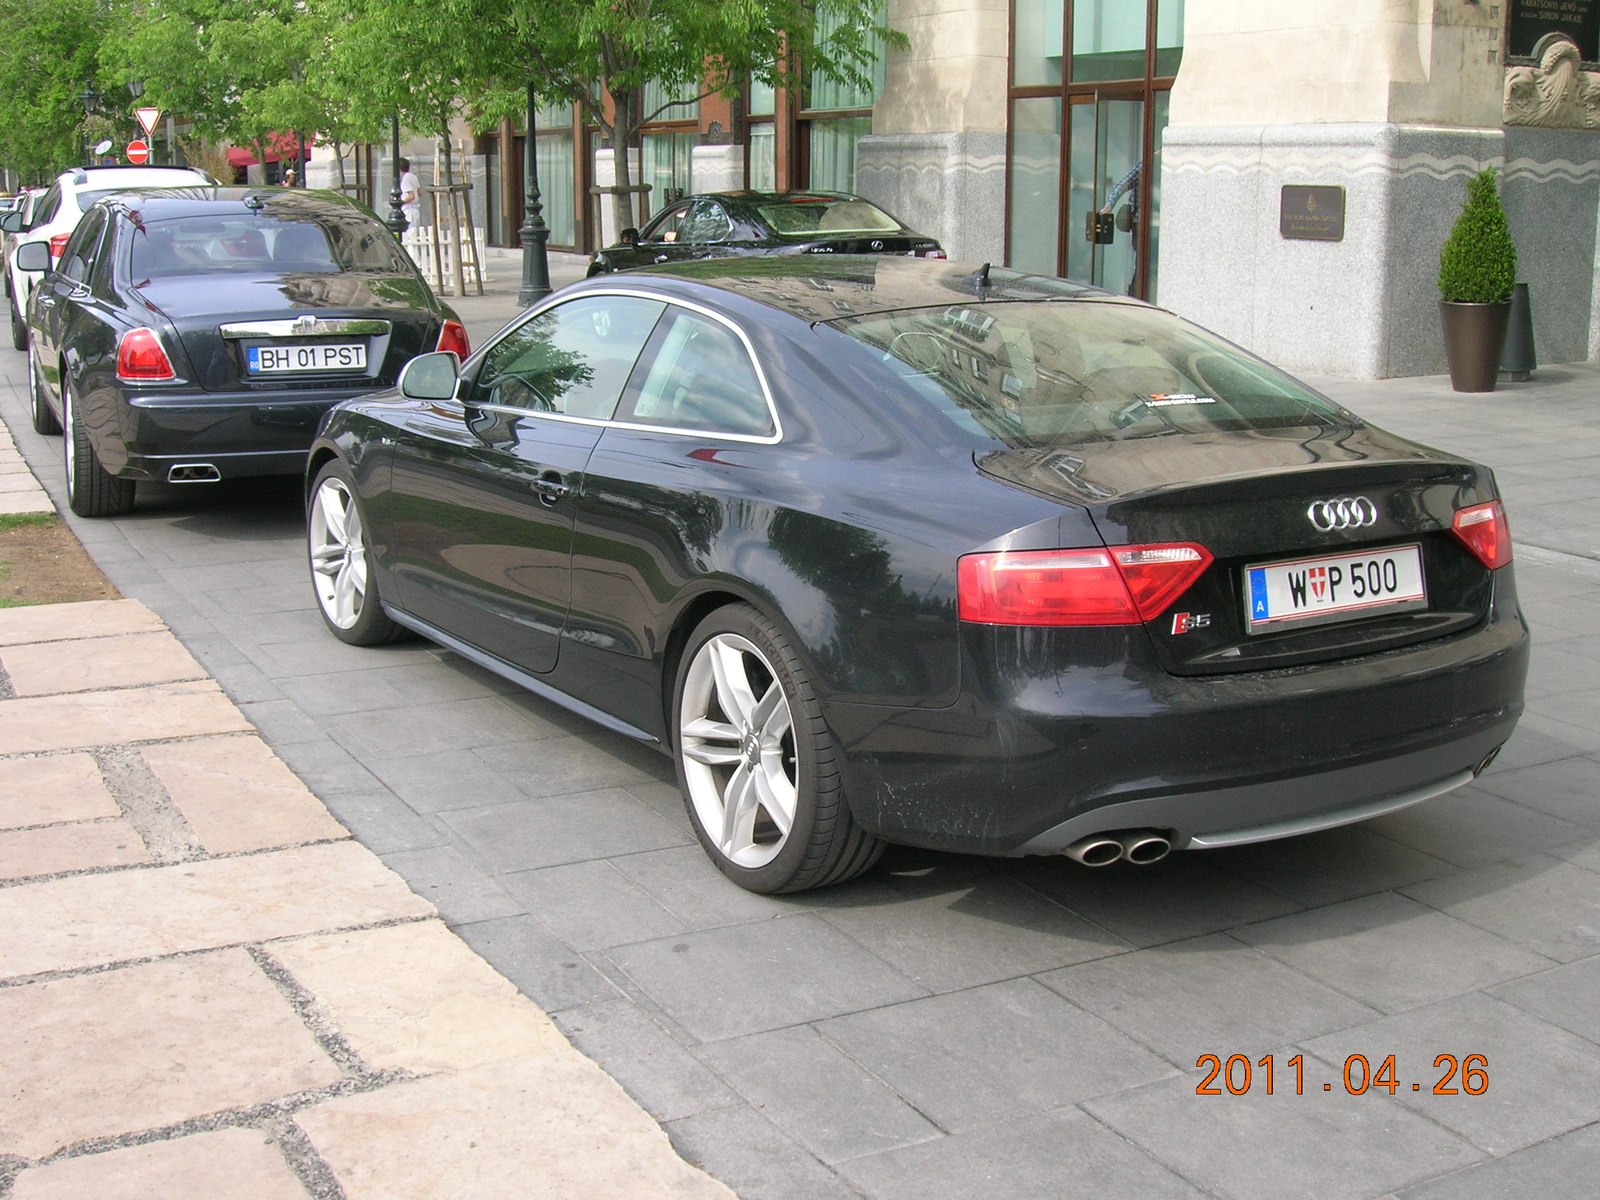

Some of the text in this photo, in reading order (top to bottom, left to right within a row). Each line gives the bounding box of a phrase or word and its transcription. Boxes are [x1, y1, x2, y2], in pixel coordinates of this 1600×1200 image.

[249, 361, 259, 370] RO
[260, 346, 363, 369] BH 01 PST
[1287, 569, 1307, 608] W
[1256, 600, 1265, 612] A
